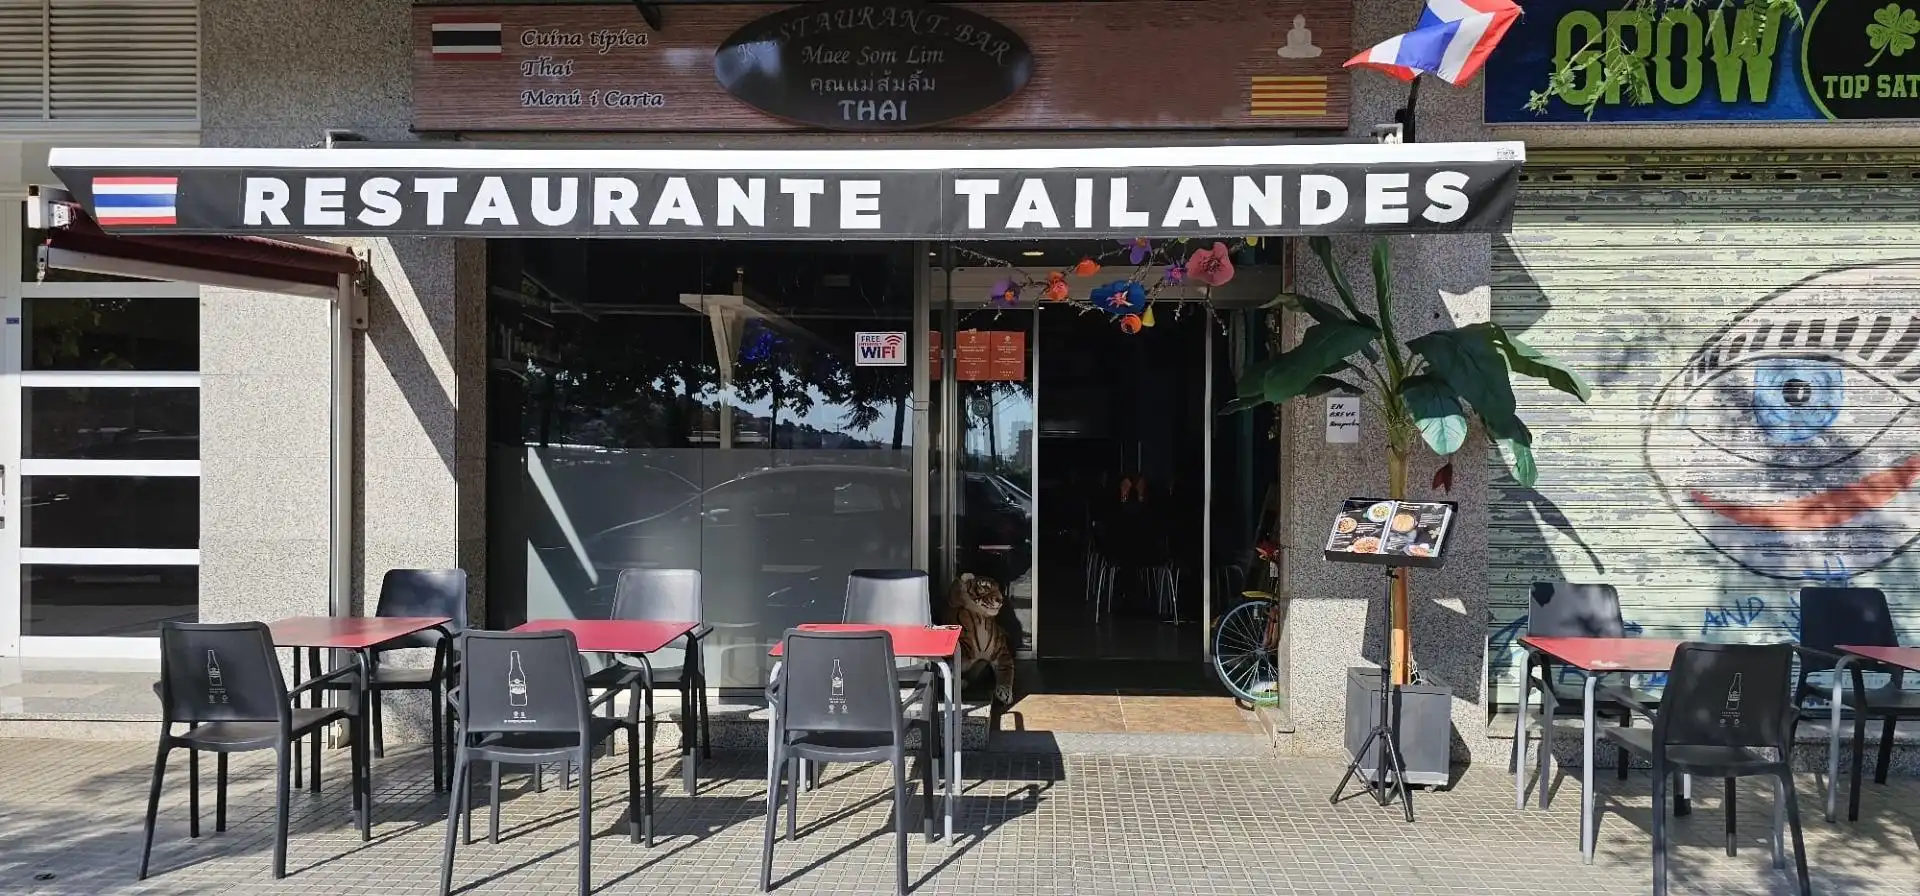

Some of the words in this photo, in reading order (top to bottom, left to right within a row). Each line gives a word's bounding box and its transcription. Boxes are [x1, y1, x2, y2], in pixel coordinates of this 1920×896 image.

[521, 56, 573, 77] Thai
[802, 45, 850, 65] Maee
[856, 45, 898, 65] Som
[906, 46, 945, 64] Lim
[1552, 9, 1782, 105] GROW
[521, 88, 582, 107] Menú
[603, 90, 664, 107] Carta
[1822, 74, 1870, 99] TOP
[837, 99, 908, 121] THAI
[243, 176, 882, 230] RESTAURANTE
[954, 170, 1471, 230] TAILANDES
[1702, 596, 1765, 635] AND
